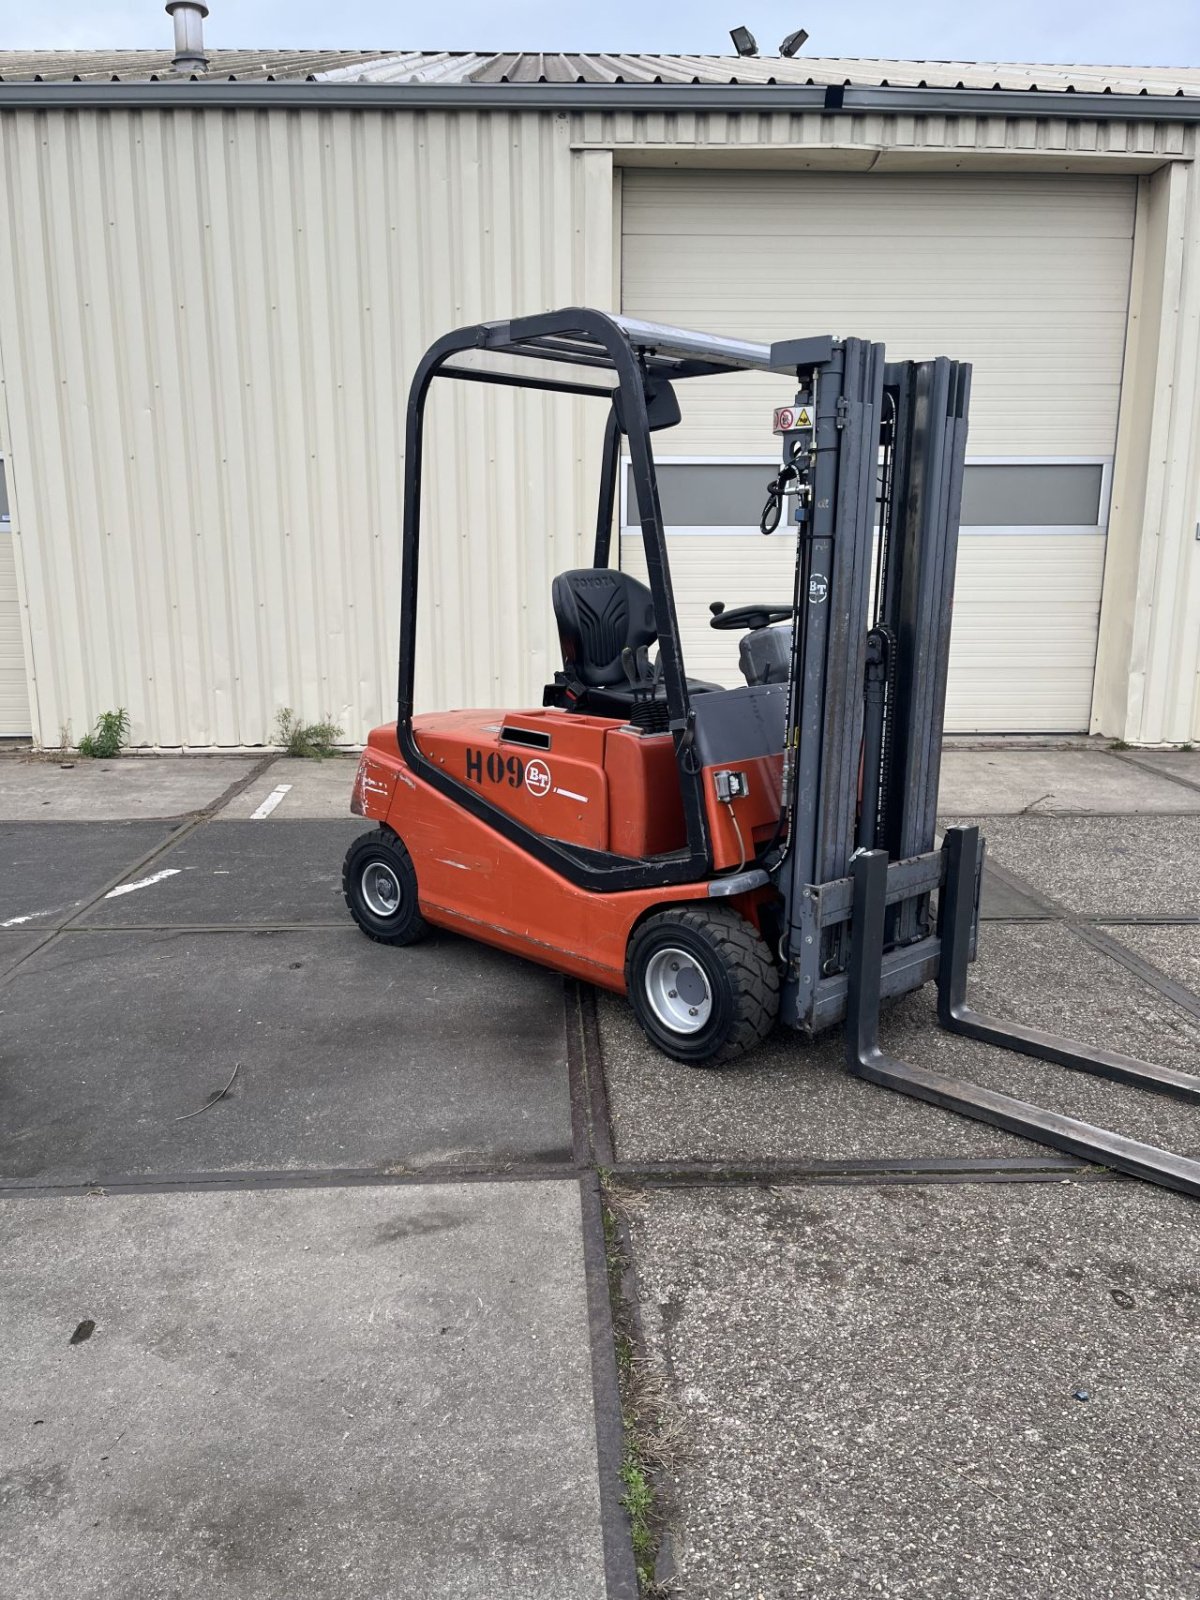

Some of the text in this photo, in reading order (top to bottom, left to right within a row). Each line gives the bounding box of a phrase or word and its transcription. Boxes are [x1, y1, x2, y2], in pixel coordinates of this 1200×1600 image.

[573, 575, 617, 588] TOYOTA
[809, 580, 827, 595] BT
[466, 748, 524, 788] H09
[529, 767, 548, 787] BT
